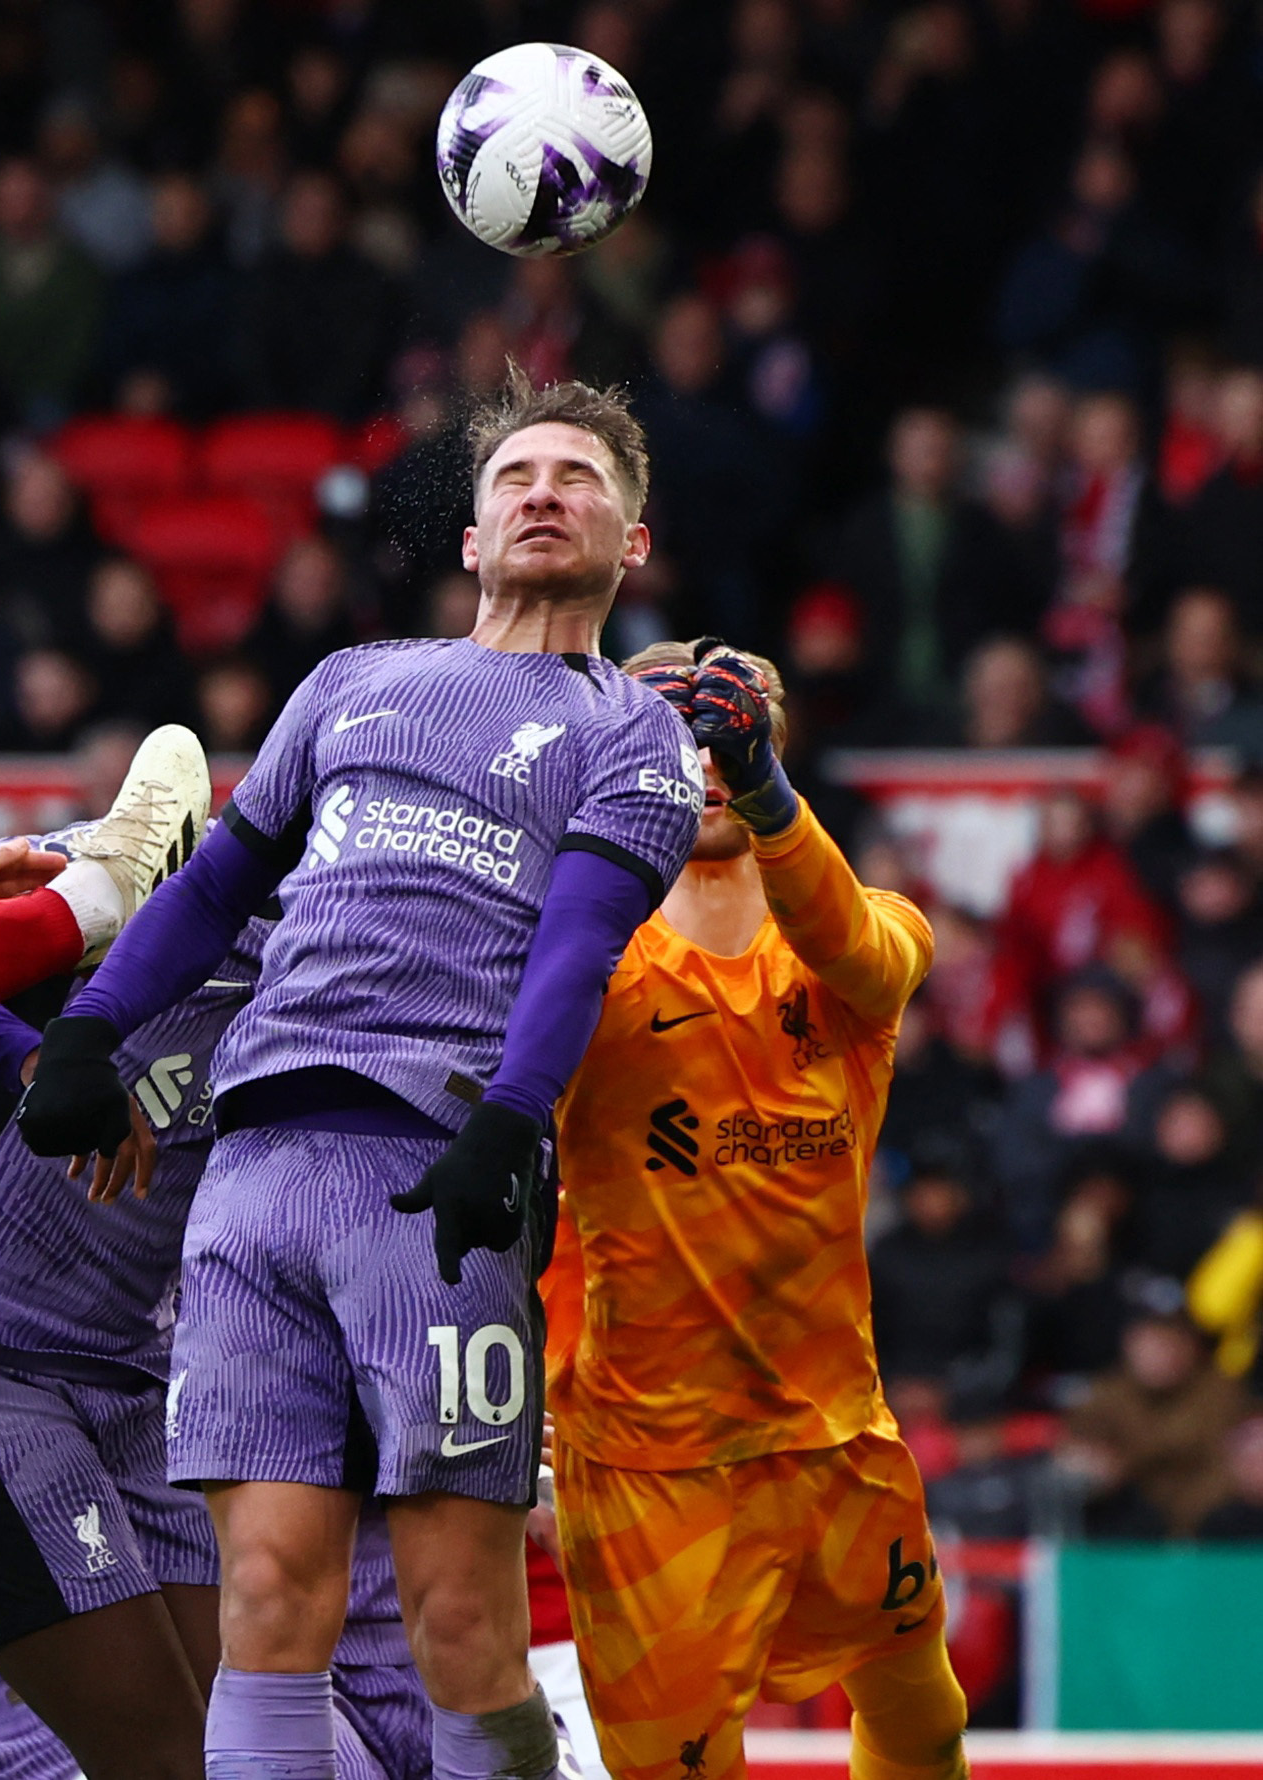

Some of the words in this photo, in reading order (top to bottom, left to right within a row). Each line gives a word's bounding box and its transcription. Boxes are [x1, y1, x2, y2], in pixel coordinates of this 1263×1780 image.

[355, 825, 521, 886] chartered
[362, 798, 524, 856] standard
[428, 1323, 525, 1426] 10
